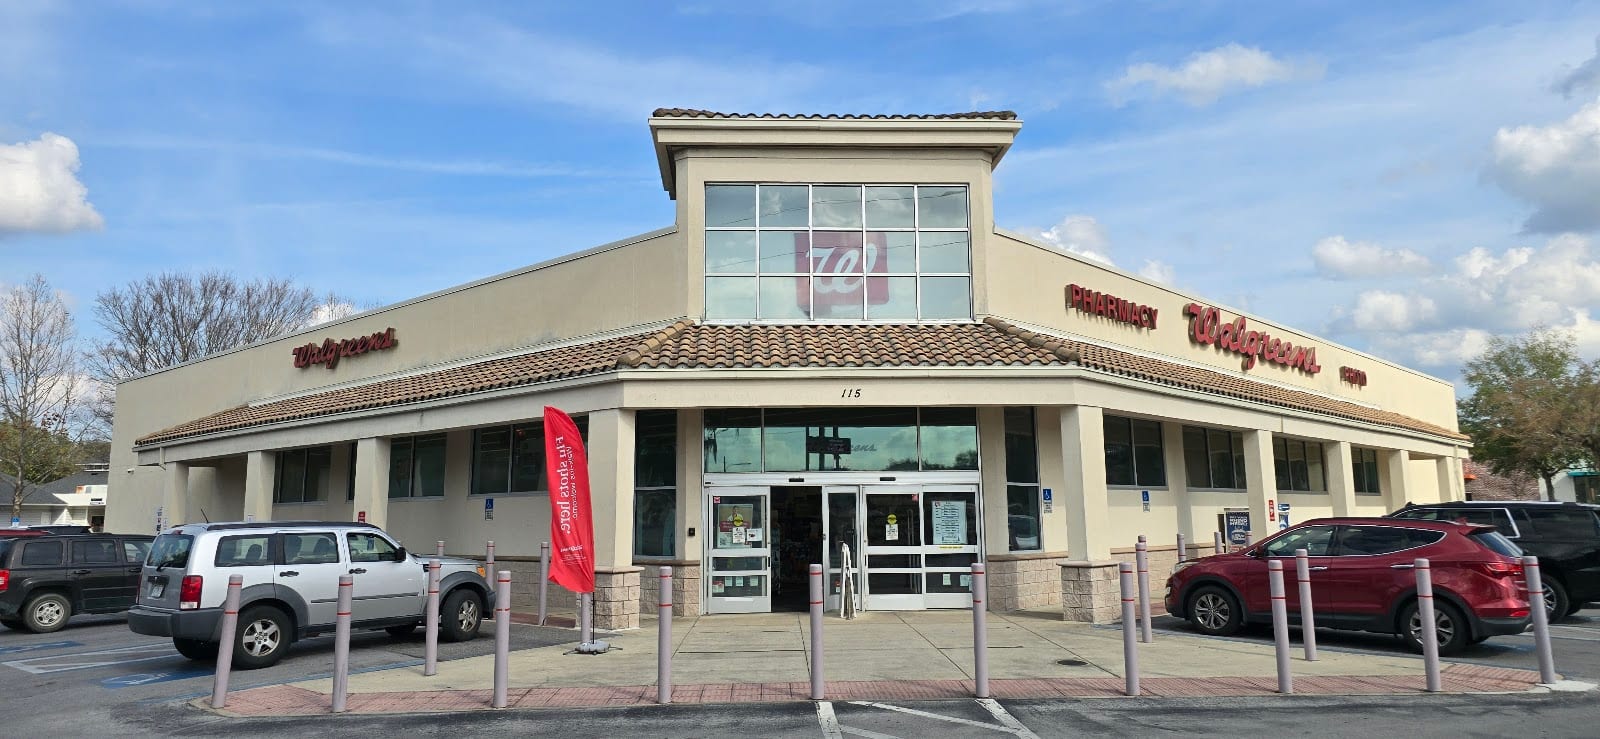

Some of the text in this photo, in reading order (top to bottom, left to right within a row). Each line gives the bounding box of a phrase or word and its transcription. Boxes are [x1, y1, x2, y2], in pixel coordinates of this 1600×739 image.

[805, 242, 878, 294] W
[1064, 284, 1158, 330] PHARMACY
[292, 327, 398, 369] Walgreens
[1183, 303, 1321, 373] Walgreens
[841, 388, 862, 398] 115
